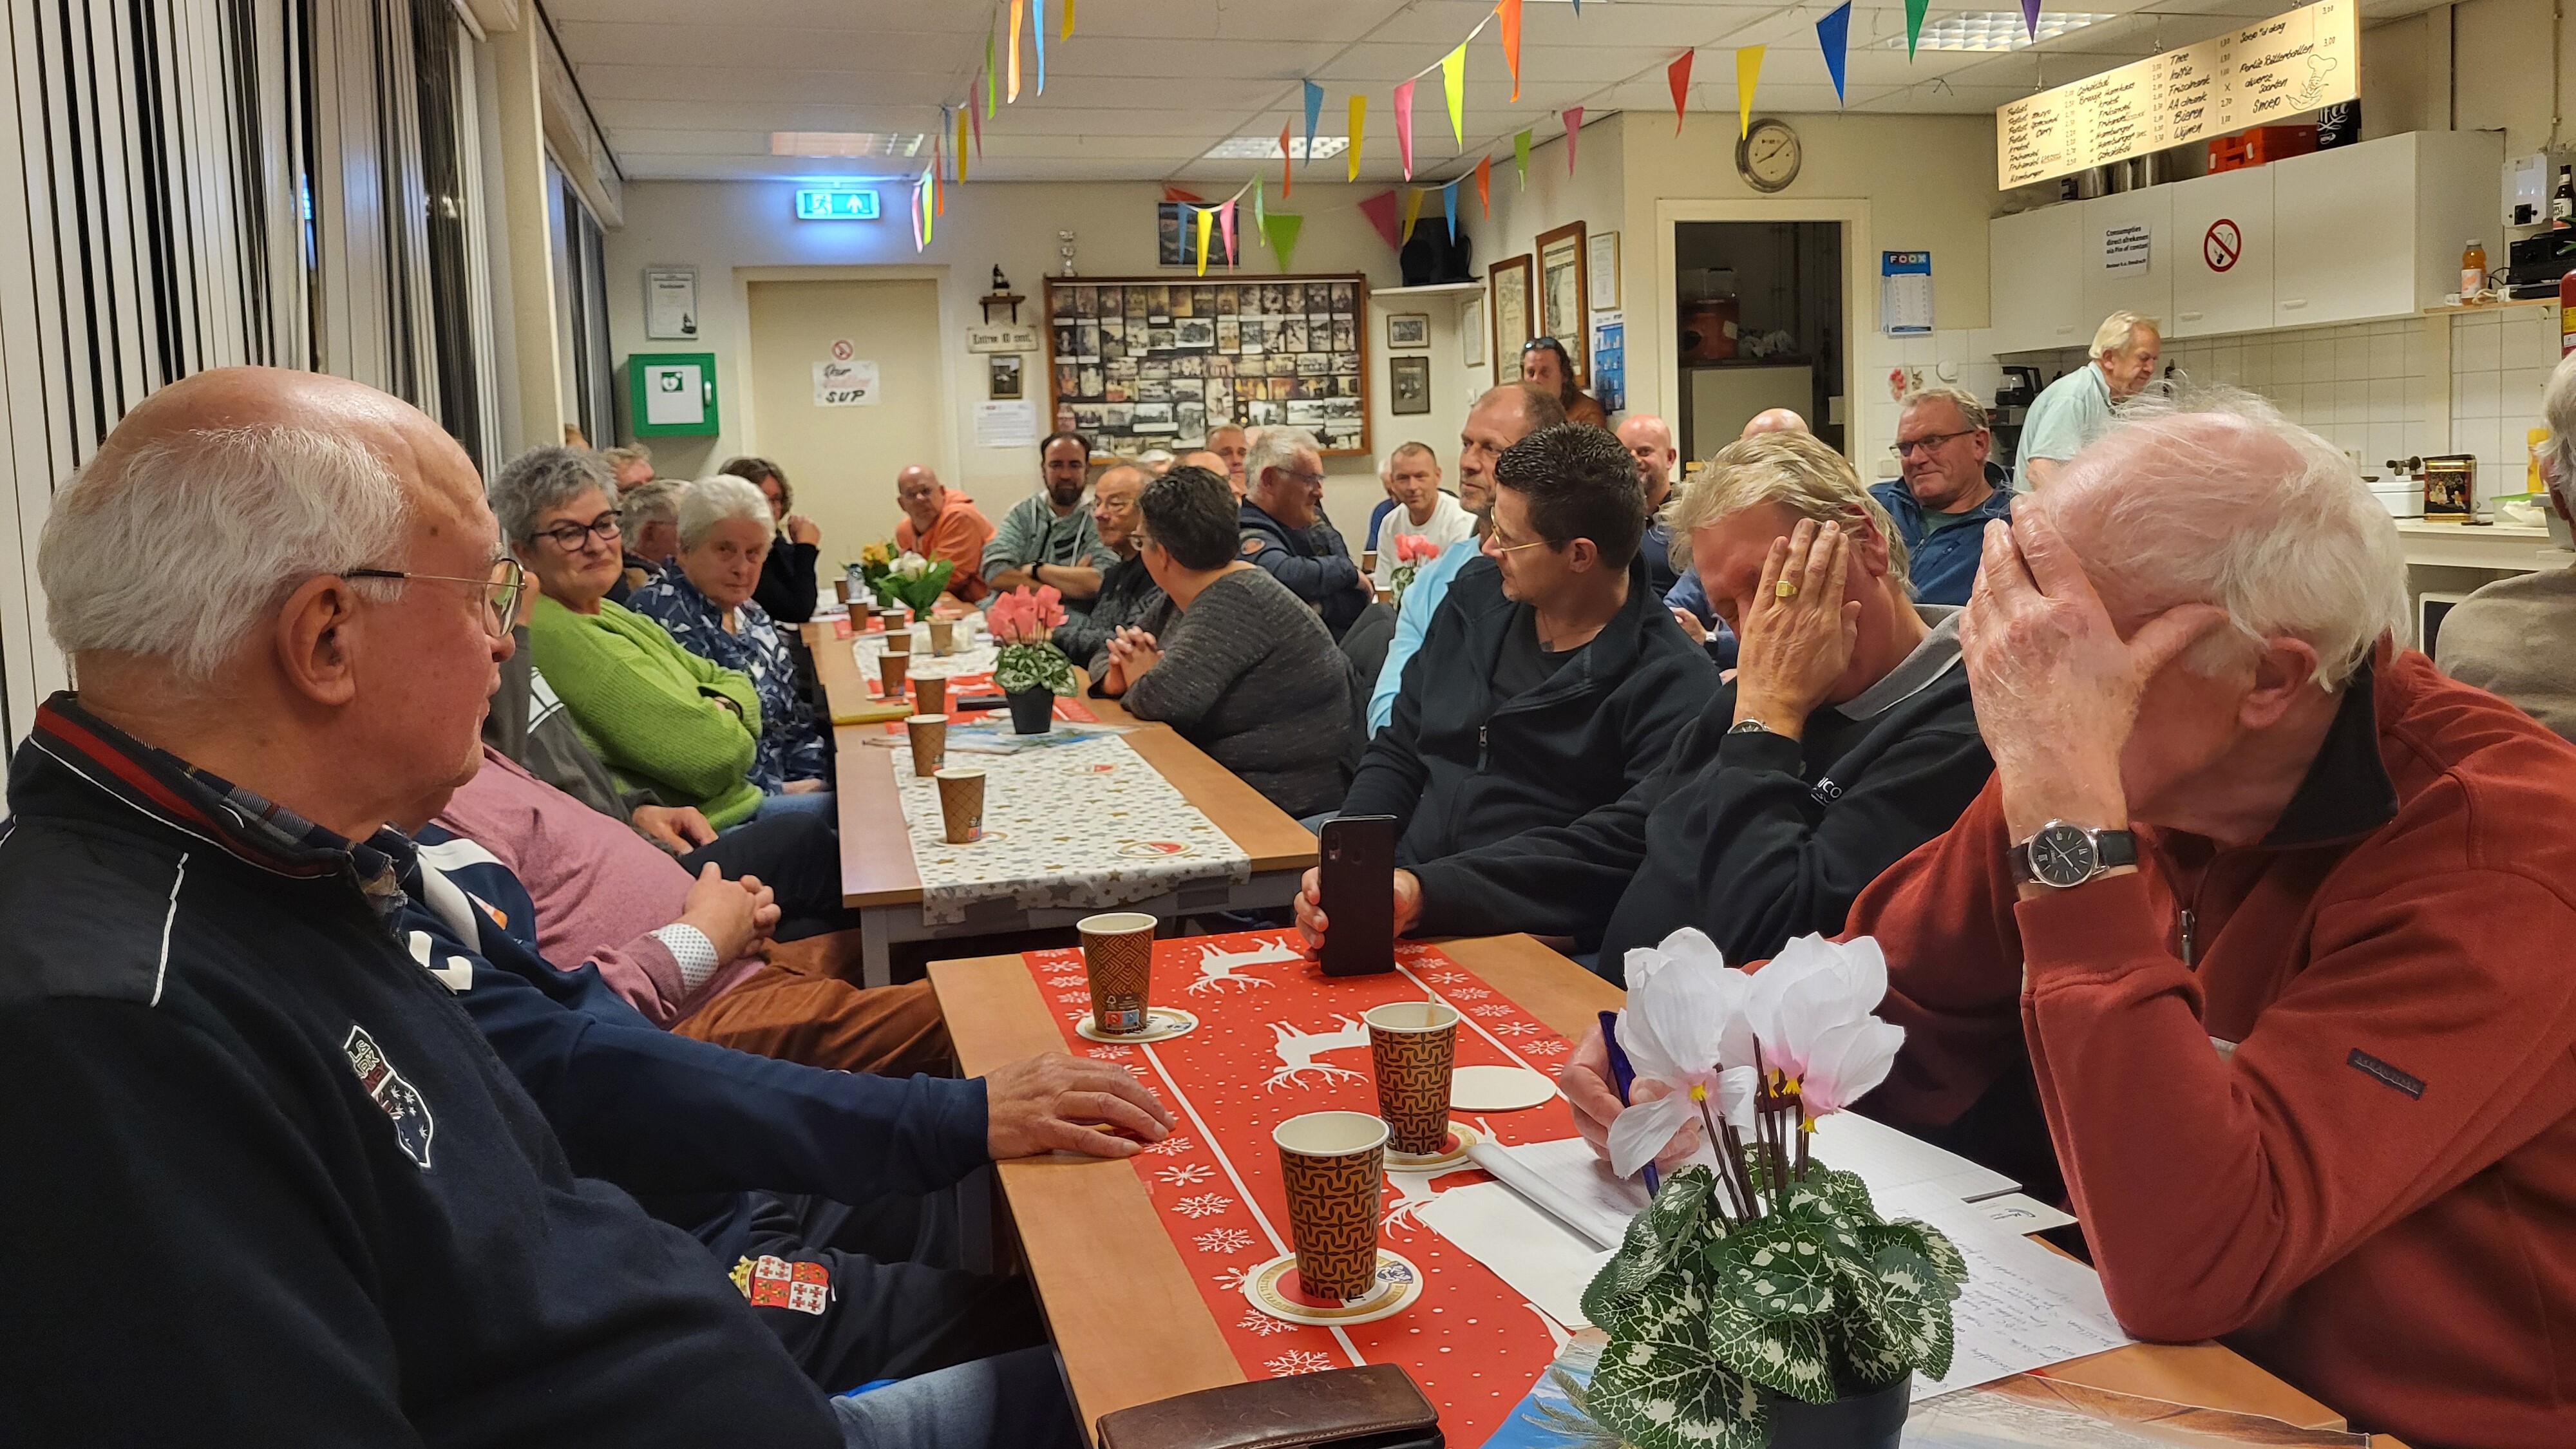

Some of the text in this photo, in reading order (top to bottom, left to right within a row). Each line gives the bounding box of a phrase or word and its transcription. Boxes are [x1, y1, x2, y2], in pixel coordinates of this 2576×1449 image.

[2170, 53, 2189, 65] Thee
[2167, 98, 2179, 111] AA
[2253, 96, 2281, 114] Snoep
[2174, 106, 2204, 124] Bieren
